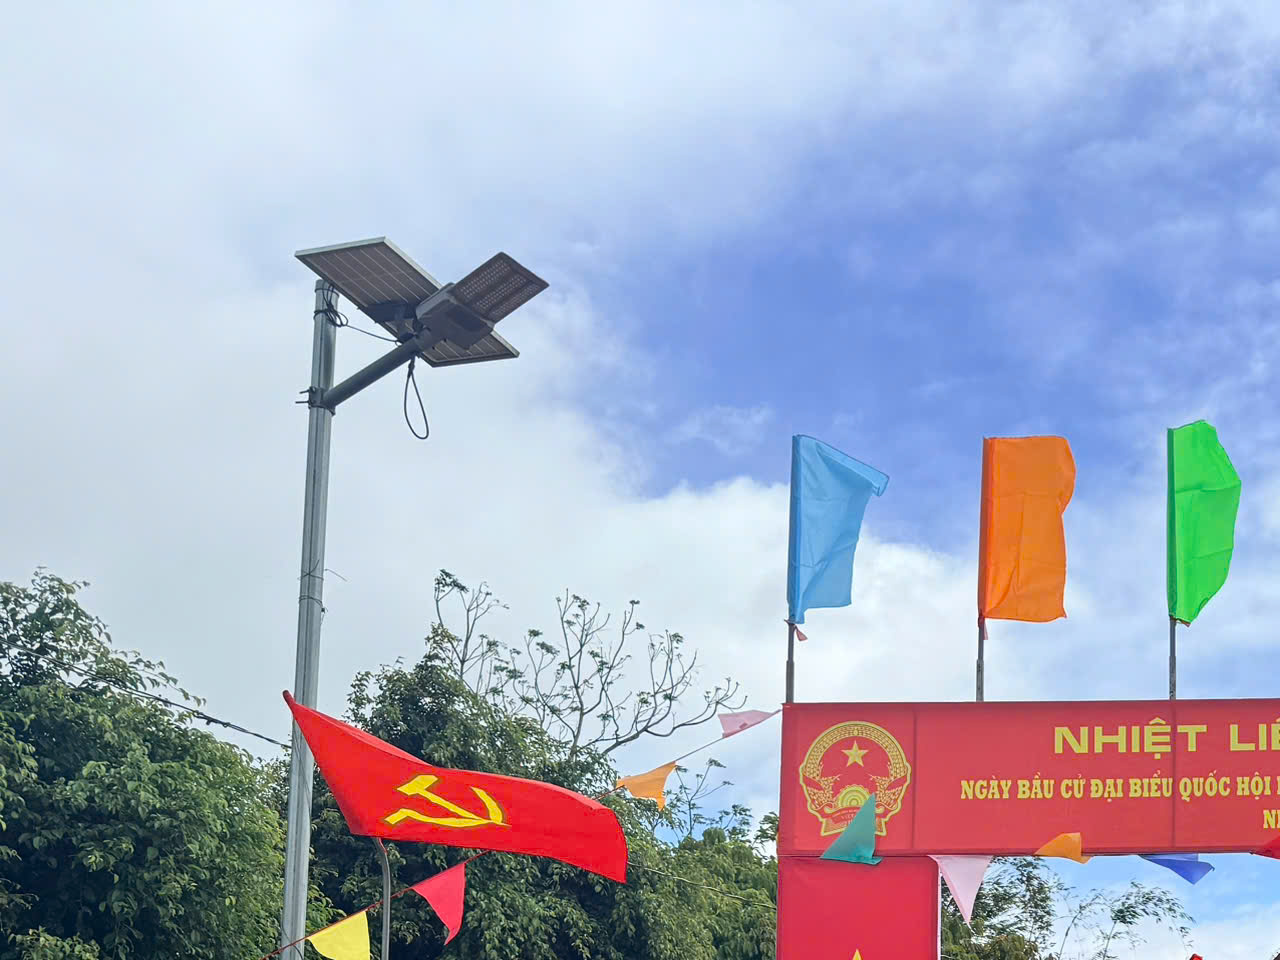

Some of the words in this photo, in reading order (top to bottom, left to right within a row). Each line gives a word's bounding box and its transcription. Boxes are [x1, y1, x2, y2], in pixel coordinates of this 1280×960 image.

[1056, 717, 1207, 759] NHIỆT
[961, 777, 1012, 799] NGÀY
[1017, 773, 1054, 799] BẦU
[1061, 774, 1085, 798] CỬ
[1090, 778, 1123, 802] ĐẠI
[1129, 771, 1173, 797] BIỂU
[1179, 771, 1230, 800] QUỐC
[1237, 773, 1271, 800] HỘI
